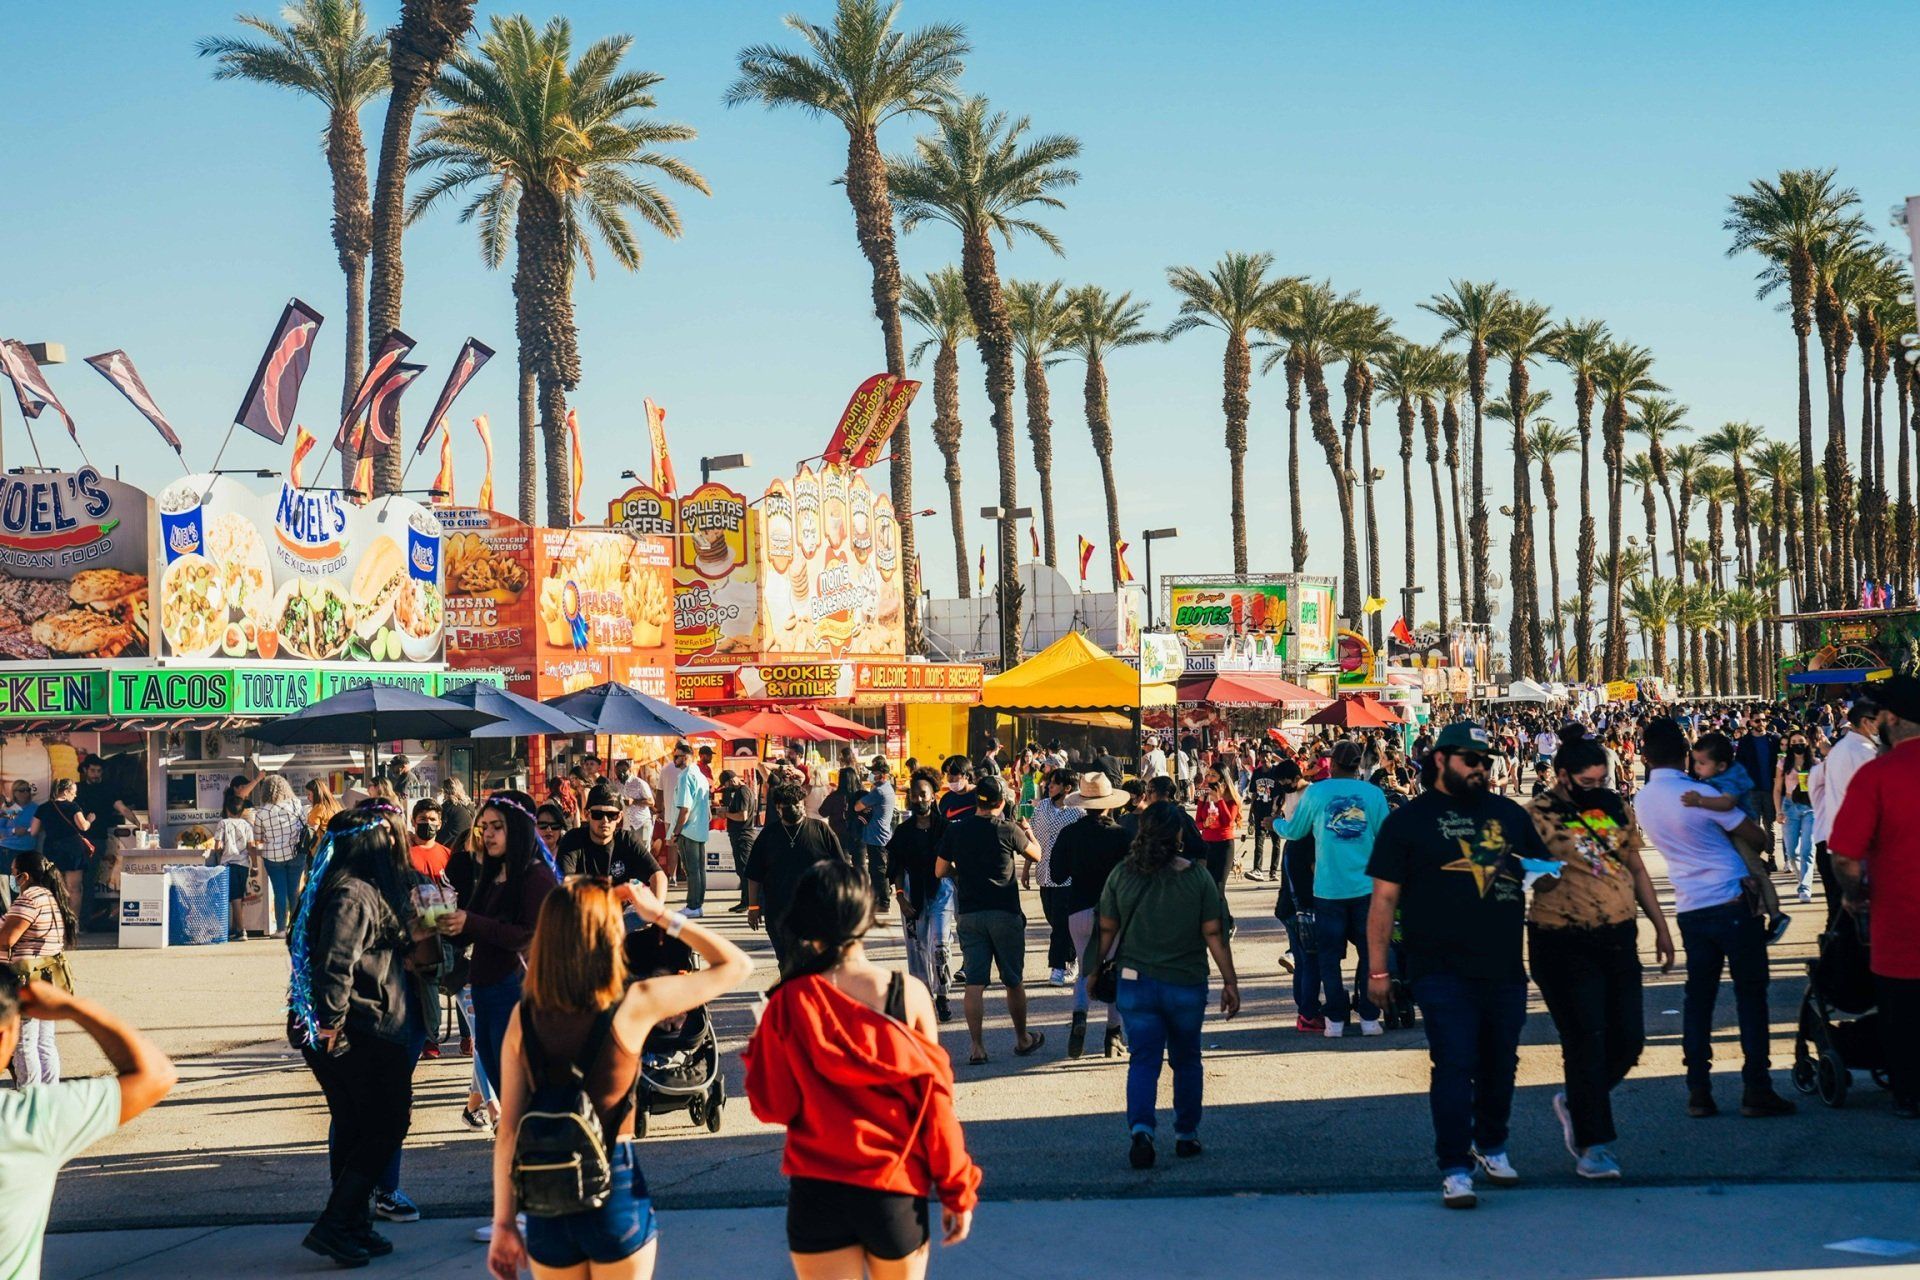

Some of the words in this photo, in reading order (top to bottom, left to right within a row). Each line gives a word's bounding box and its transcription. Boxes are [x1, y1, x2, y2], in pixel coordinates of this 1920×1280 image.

[843, 377, 887, 450] AKESHOPPE
[0, 469, 111, 531] OEL'S
[622, 499, 660, 517] ICED
[681, 498, 744, 519] GALLETAS
[276, 482, 347, 543] NOEL'S
[457, 519, 488, 527] CHIPS
[458, 510, 478, 518] CUT
[699, 514, 738, 531] LECHE
[61, 539, 113, 566] FOOD
[276, 545, 320, 576] MEXICAN
[322, 556, 348, 575] FOOD
[1176, 605, 1232, 626] ELOTES
[456, 628, 522, 650] CHIPS
[488, 665, 515, 674] Crispy
[759, 665, 842, 681] COOKIES
[1185, 657, 1215, 670] Rolls
[680, 675, 724, 688] COOKIES
[766, 681, 783, 696] &
[788, 681, 837, 696] MILK
[872, 667, 907, 688] WELCOME
[912, 667, 921, 688] TO
[948, 667, 981, 689] BAKESHOPPE
[118, 674, 227, 711] TACOS
[242, 674, 308, 708] TORTAS
[198, 773, 230, 781] CALIFORNIA
